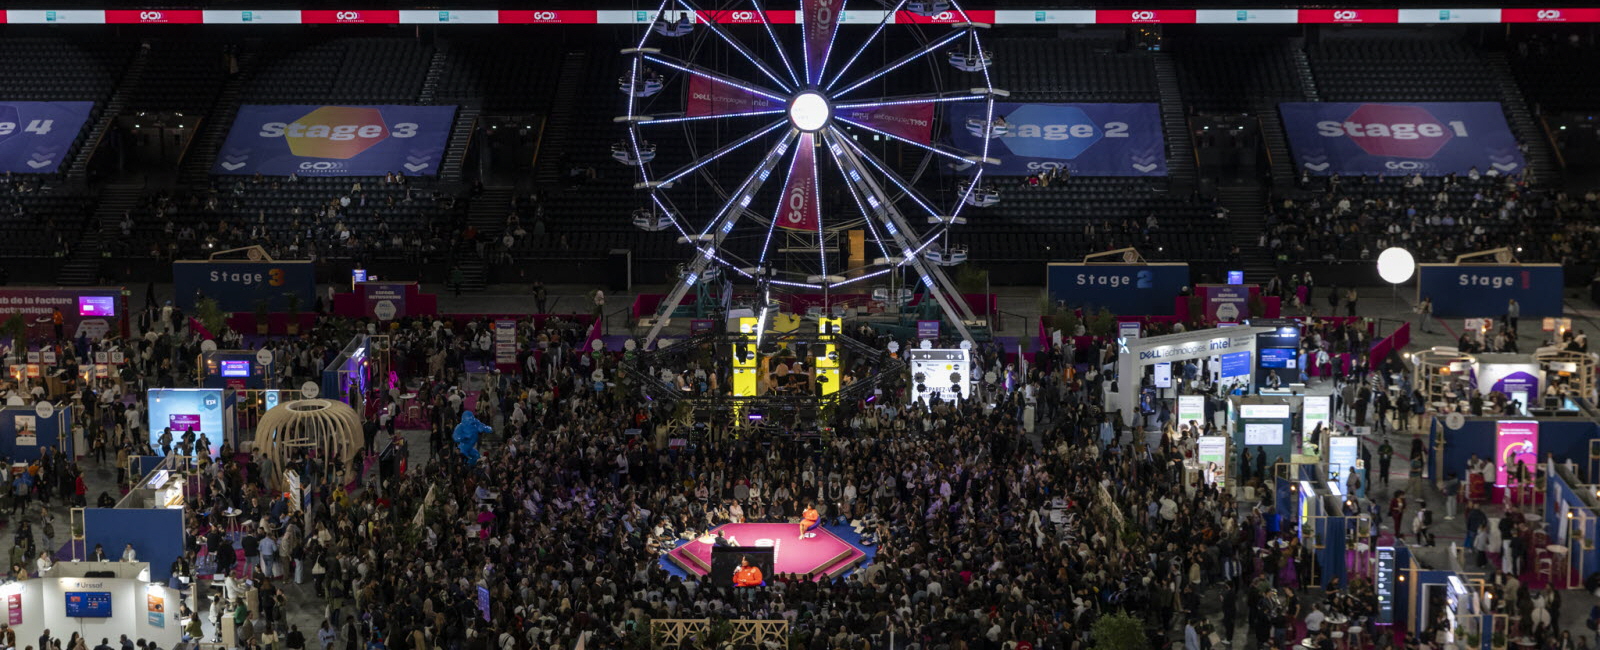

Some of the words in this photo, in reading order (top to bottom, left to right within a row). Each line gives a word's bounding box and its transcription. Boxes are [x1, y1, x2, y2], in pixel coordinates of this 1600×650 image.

[24, 120, 54, 134] 4
[259, 122, 383, 140] Stage
[392, 122, 419, 138] 3
[1003, 123, 1094, 141] tage
[1104, 121, 1130, 138] 2
[1316, 120, 1443, 140] Stage
[1448, 120, 1469, 137] 1
[210, 271, 263, 285] Stage
[268, 268, 285, 287] 3
[1076, 274, 1130, 288] Stage
[1137, 270, 1153, 289] 2
[1459, 274, 1514, 289] Stage
[1521, 271, 1530, 289] 1
[10, 296, 23, 305] de
[24, 296, 34, 305] la
[34, 296, 73, 305] facture
[1140, 350, 1162, 360] DELL
[1162, 345, 1207, 358] Technologies
[1210, 338, 1231, 351] intel
